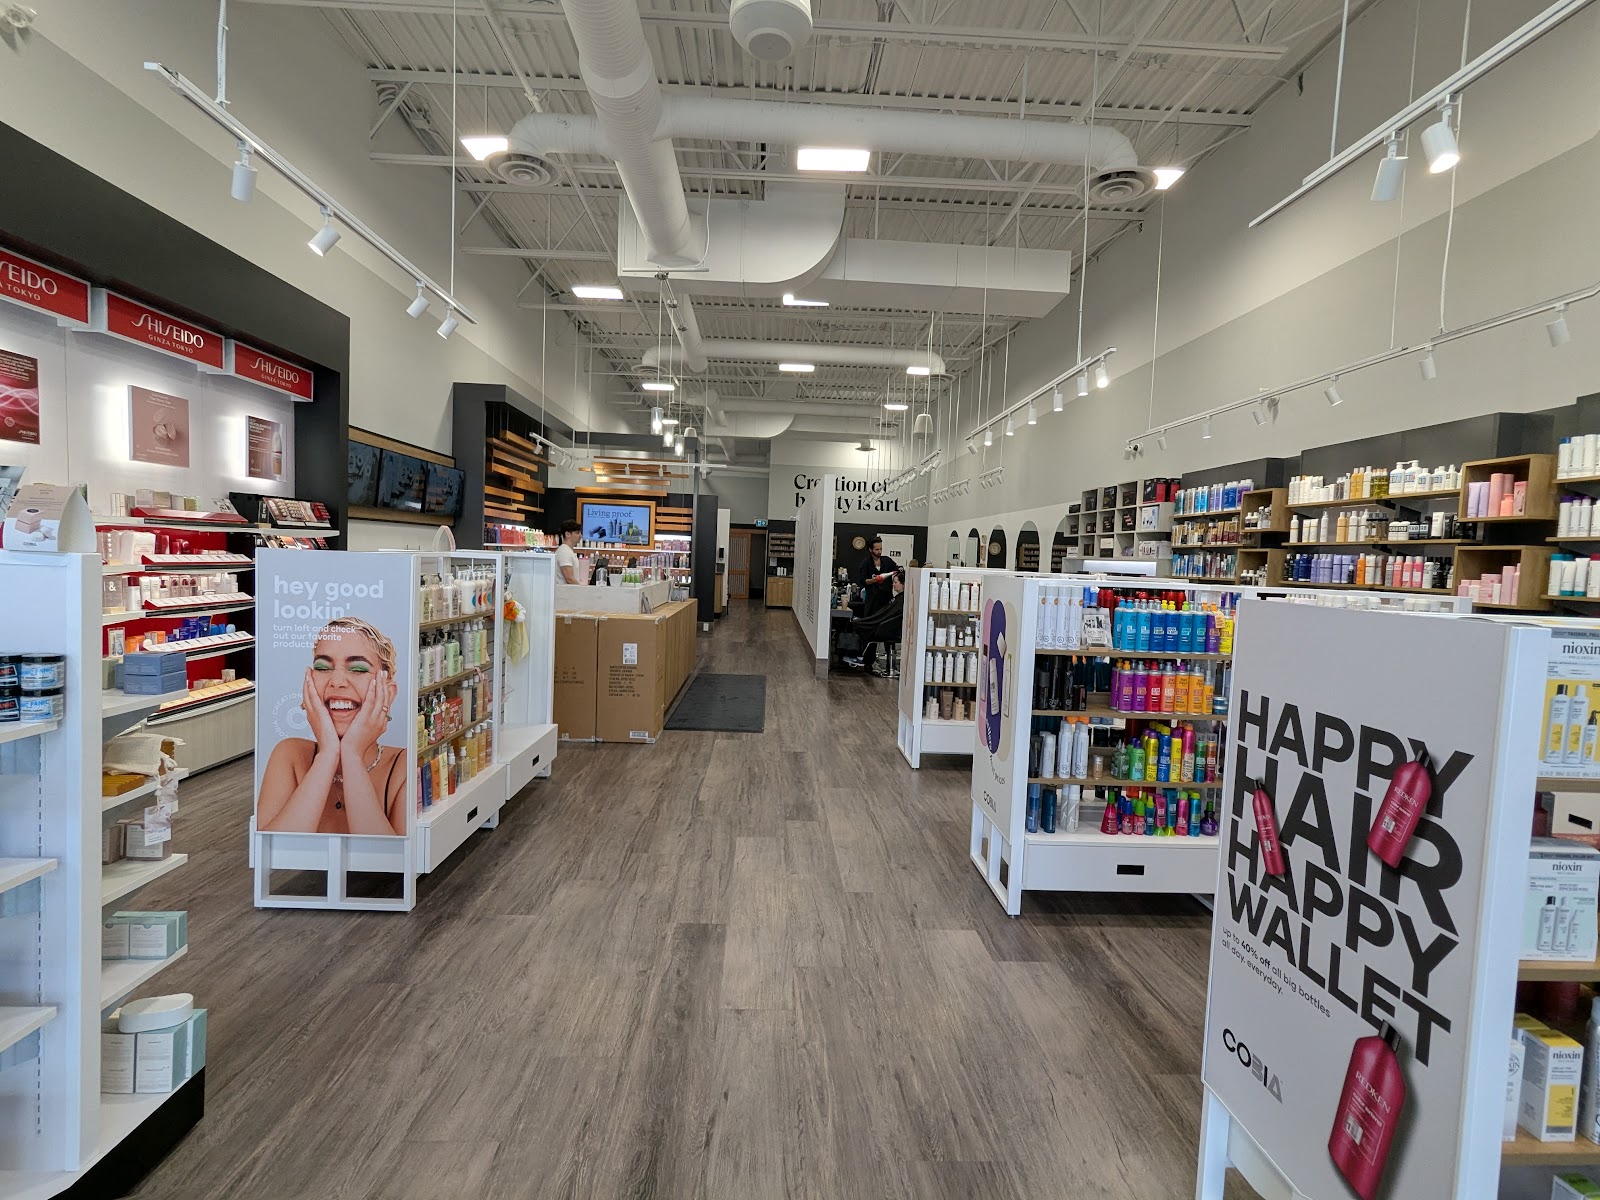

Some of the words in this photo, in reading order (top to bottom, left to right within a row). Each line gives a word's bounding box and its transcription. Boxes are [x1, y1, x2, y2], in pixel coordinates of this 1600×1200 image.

[6, 283, 41, 301] TOKYO
[131, 313, 204, 349] SHISEIDO
[148, 334, 171, 347] GINZA
[172, 341, 194, 354] TOKYO
[250, 357, 299, 384] SHISEIDO
[794, 474, 867, 493] Cretion
[871, 477, 890, 493] of
[587, 508, 611, 518] Living
[795, 492, 853, 514] bty
[857, 495, 871, 511] is
[274, 575, 319, 600] hey
[325, 580, 384, 601] good
[274, 599, 350, 620] lookin'
[273, 624, 293, 632] turn
[294, 624, 310, 632] left
[312, 624, 329, 633] and
[331, 624, 356, 634] check
[308, 632, 342, 641] favorite
[1562, 641, 1600, 655] nioxin
[1237, 689, 1475, 820] HAPPY
[1232, 743, 1464, 937] HAIR
[1552, 861, 1583, 872] nioxin
[1227, 817, 1460, 999] HAPPY
[1221, 939, 1231, 950] all
[1246, 959, 1283, 995] everyday.
[1222, 926, 1232, 939] up
[1232, 933, 1240, 945] to
[1241, 940, 1259, 960] 40%
[1259, 956, 1271, 970] off
[1271, 966, 1282, 979] all
[1283, 972, 1297, 993] big
[1298, 984, 1331, 1018] bottles
[1227, 870, 1452, 1068] WALLET
[1222, 1028, 1283, 1104] COBIA
[1553, 1051, 1581, 1060] nioxin
[1355, 1070, 1391, 1114] REDKEN
